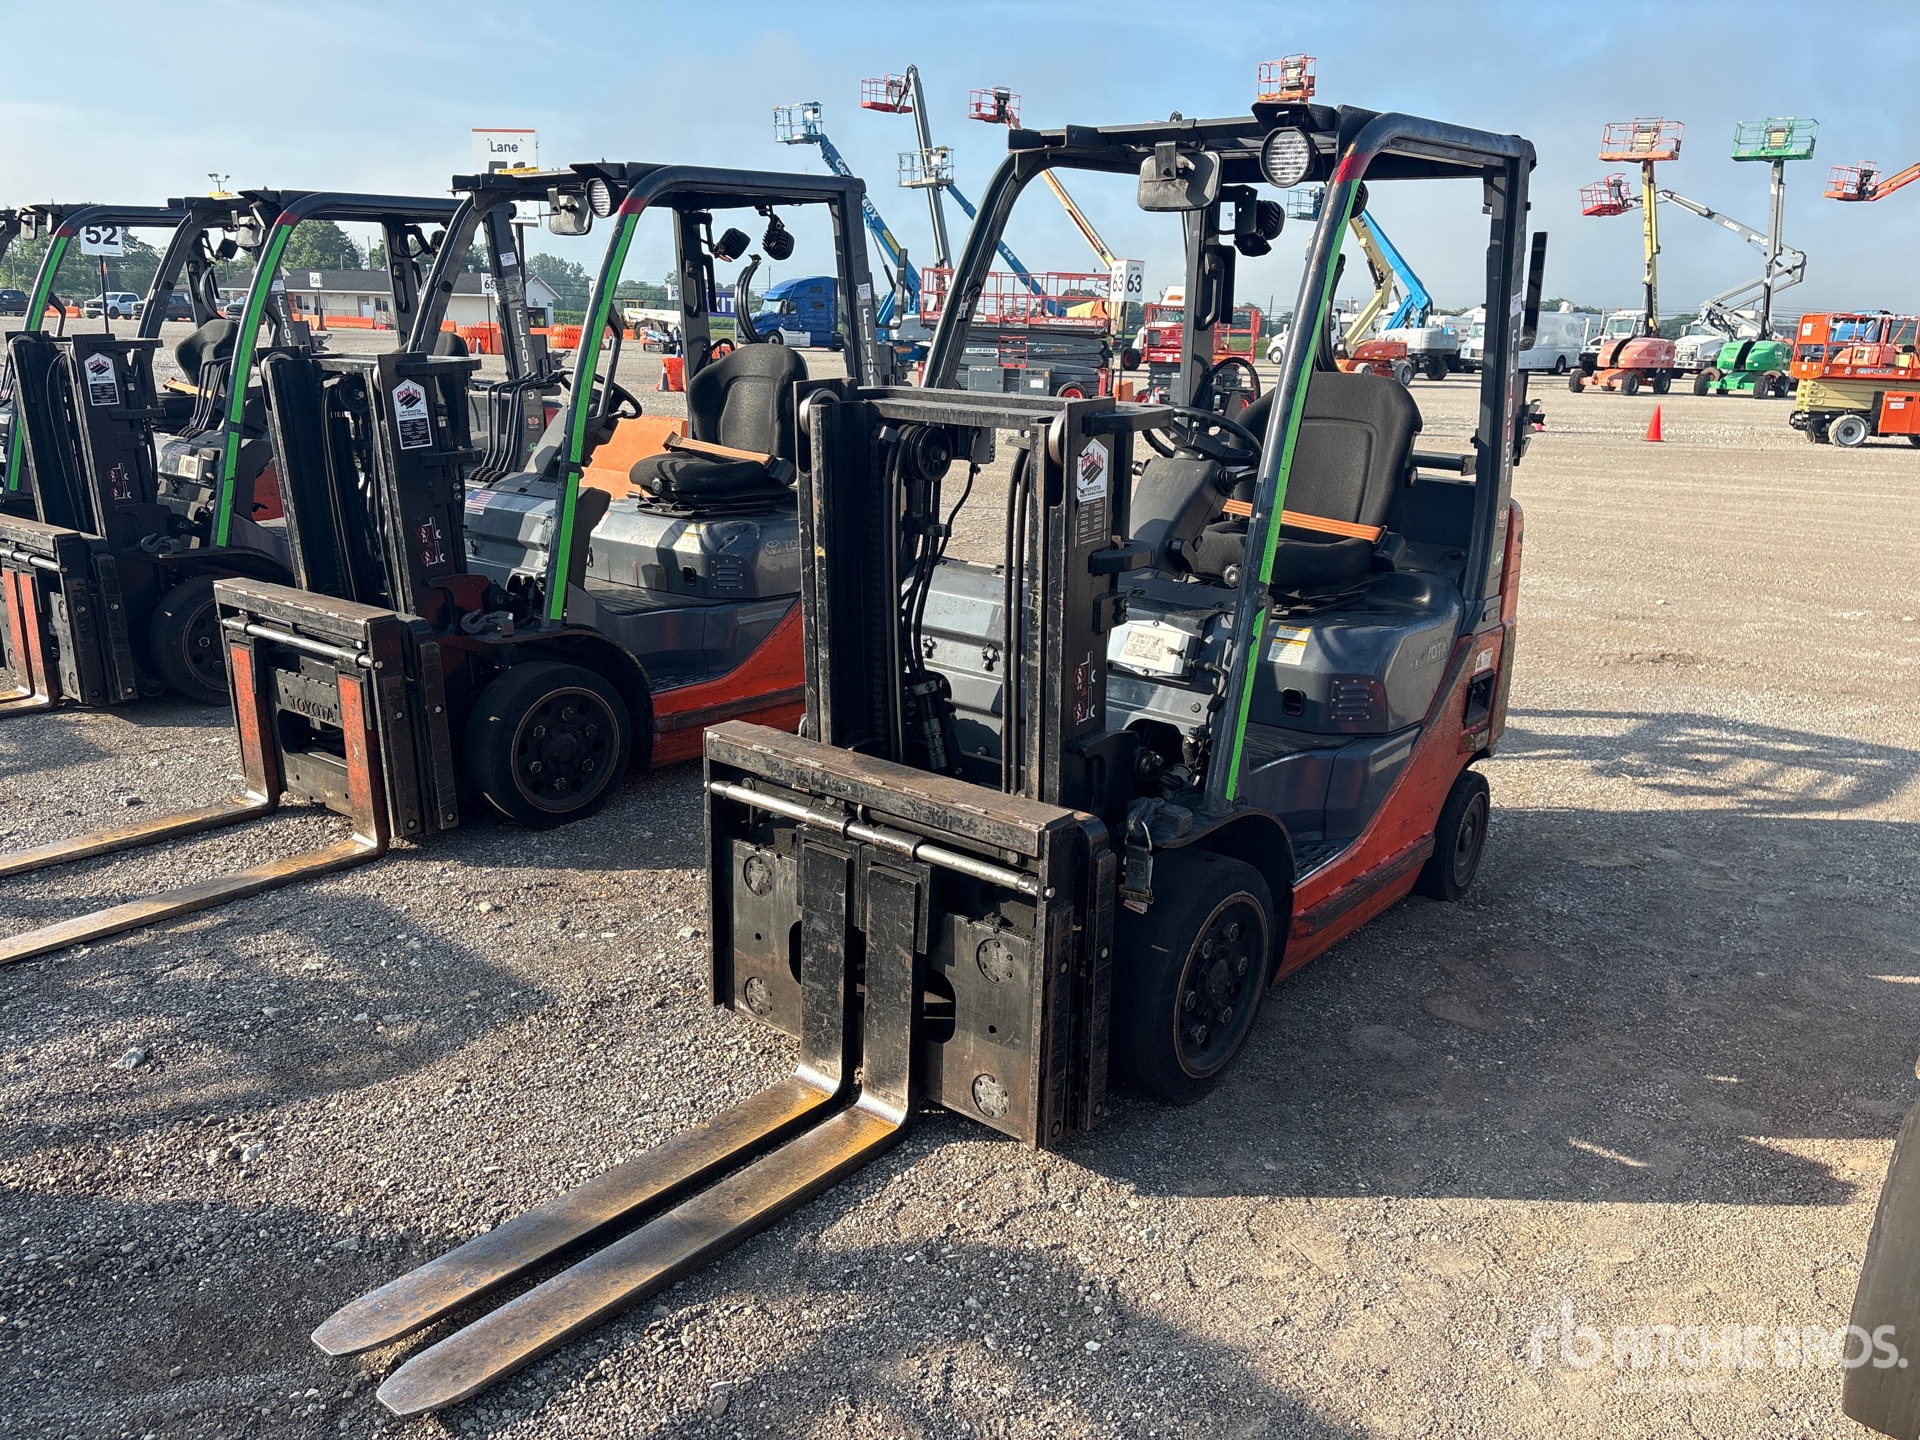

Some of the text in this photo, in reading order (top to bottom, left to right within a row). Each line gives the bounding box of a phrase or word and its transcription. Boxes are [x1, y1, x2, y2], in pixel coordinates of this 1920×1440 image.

[490, 140, 519, 153] Lane
[861, 200, 879, 220] 60X
[85, 225, 119, 246] 52
[311, 276, 319, 285] 56
[1112, 273, 1124, 292] 63
[1126, 273, 1143, 293] 63
[397, 385, 421, 400] ProLift
[1081, 448, 1104, 470] ProLift
[289, 695, 336, 723] TOYOTA
